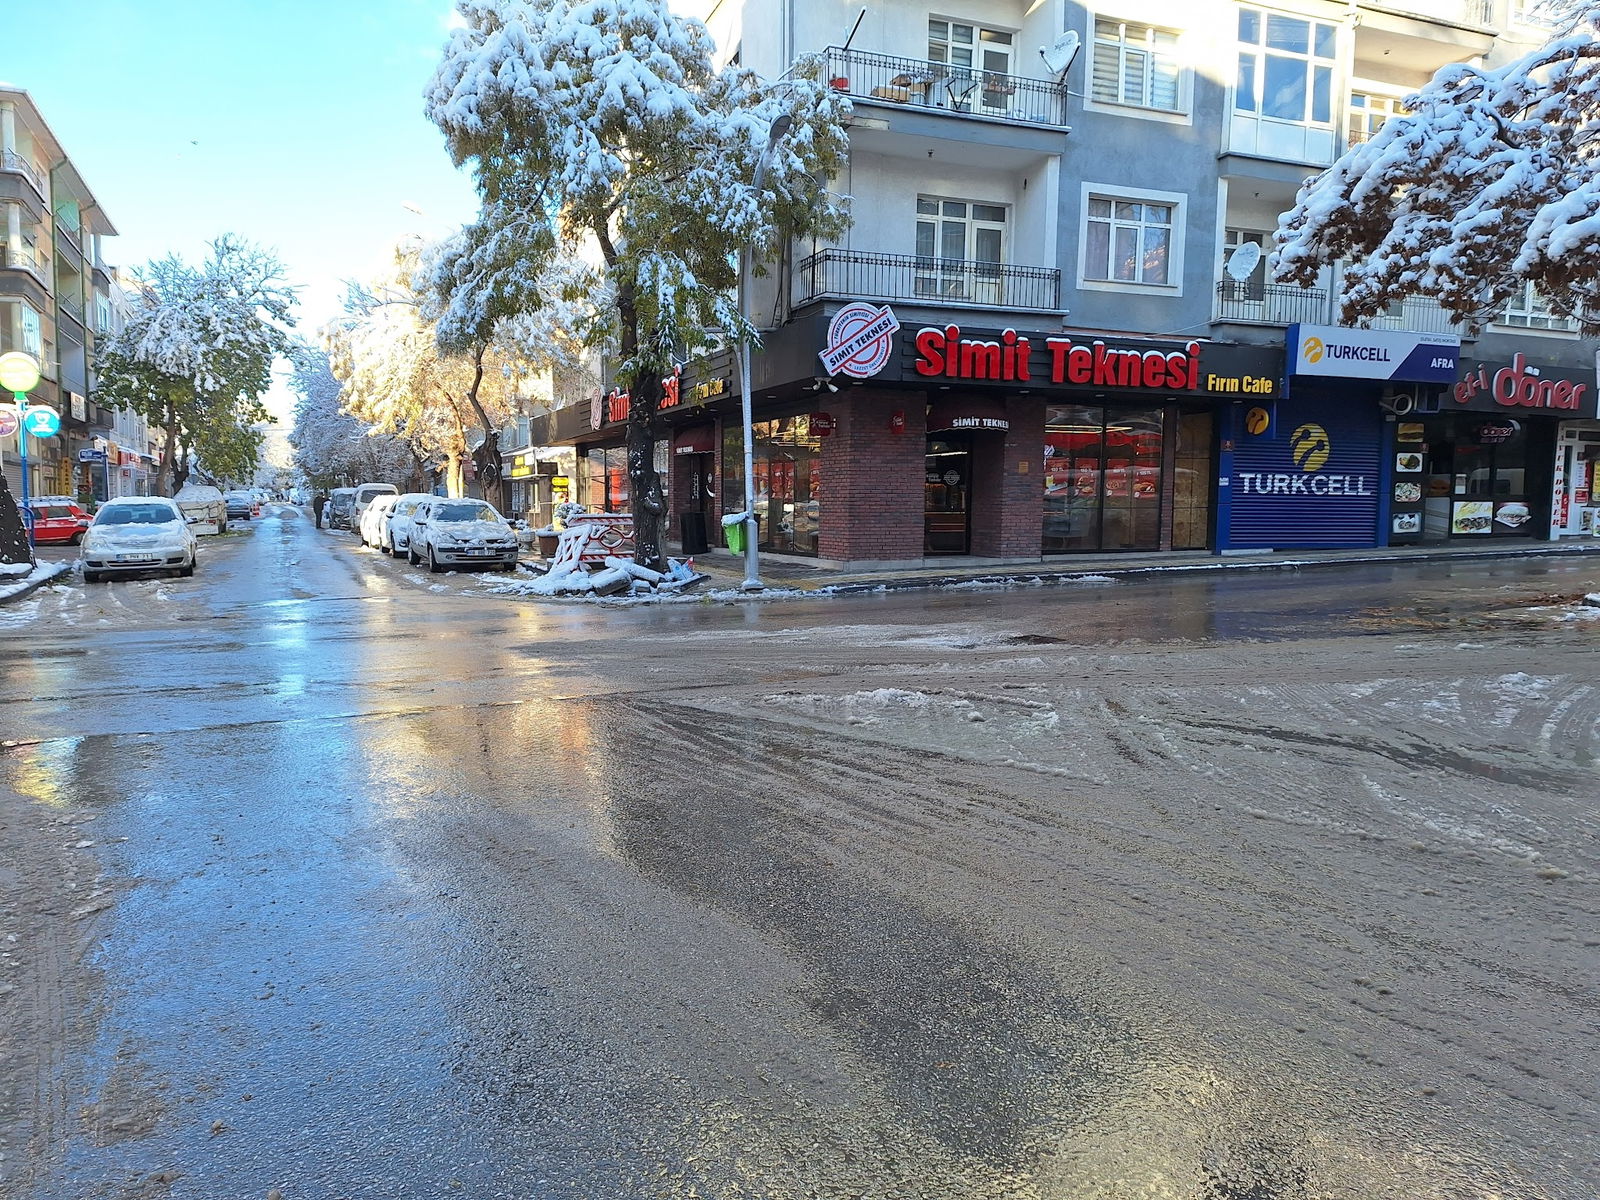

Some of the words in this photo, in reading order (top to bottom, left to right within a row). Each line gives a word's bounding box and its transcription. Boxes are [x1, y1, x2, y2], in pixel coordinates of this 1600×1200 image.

[829, 344, 855, 367] SİMİT
[855, 316, 893, 348] TEKNESİ
[1326, 343, 1391, 362] TURKCELL
[915, 323, 1031, 381] Simit
[1046, 338, 1201, 390] Teknesi
[1430, 357, 1455, 369] AFRA
[1207, 373, 1239, 393] Fırın
[1242, 375, 1273, 394] Cafe
[1493, 352, 1587, 410] döner
[952, 416, 980, 427] SİMİT
[1239, 473, 1372, 496] TURKCELL
